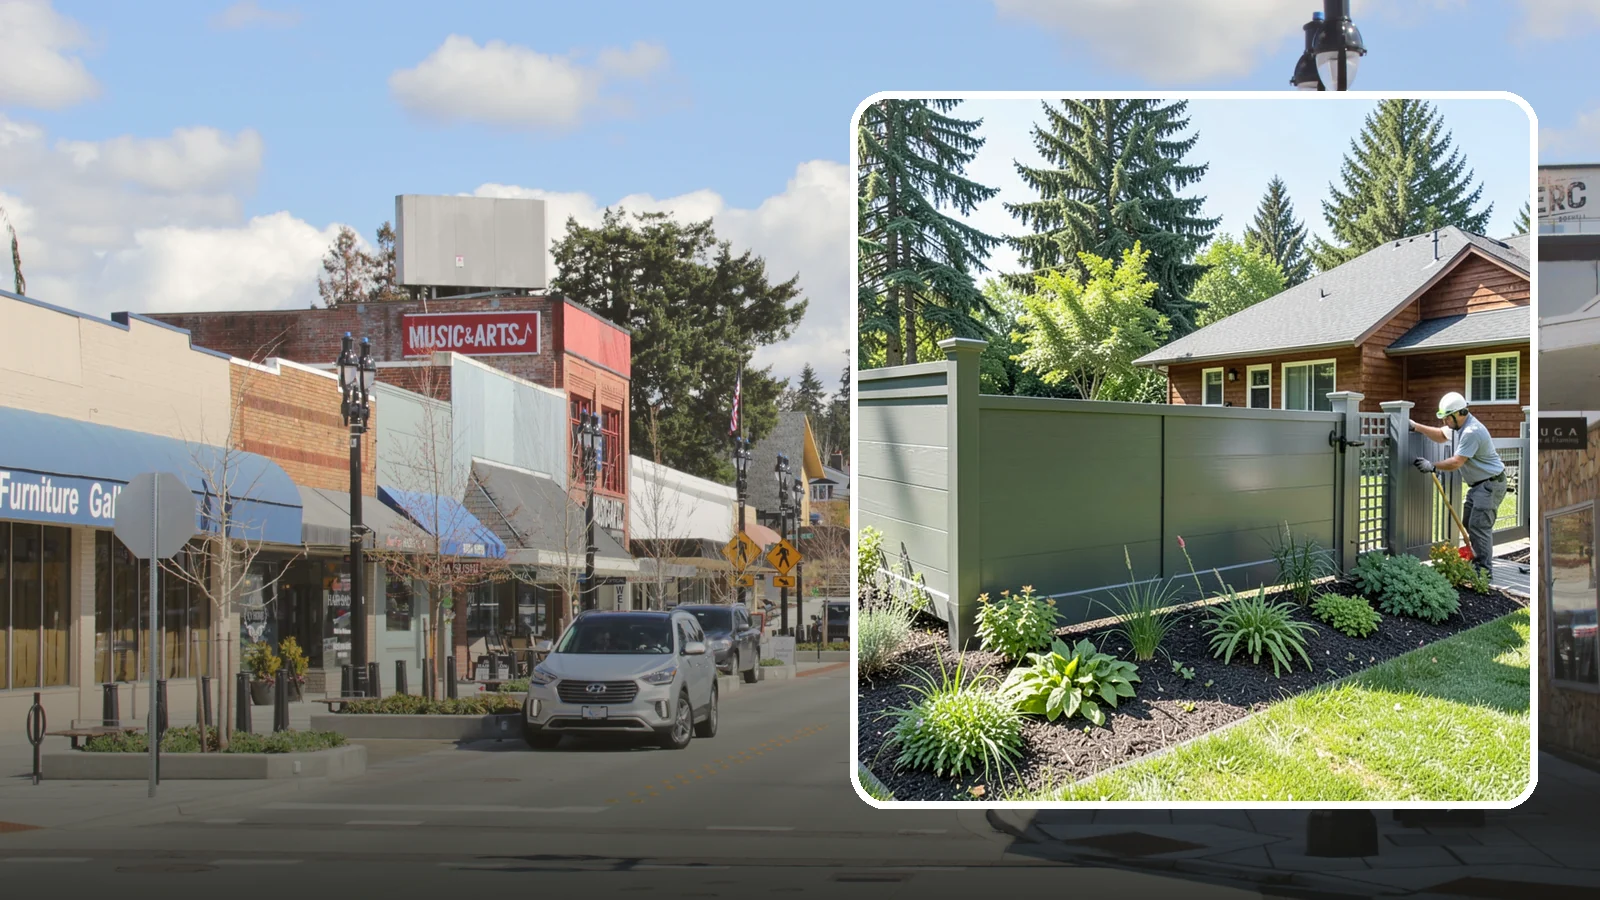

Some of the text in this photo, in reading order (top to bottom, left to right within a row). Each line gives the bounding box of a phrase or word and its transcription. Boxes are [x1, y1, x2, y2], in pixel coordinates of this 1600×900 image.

[408, 322, 520, 349] MUSIC&ARTS
[1540, 427, 1577, 437] UGA
[0, 471, 79, 515] Furniture
